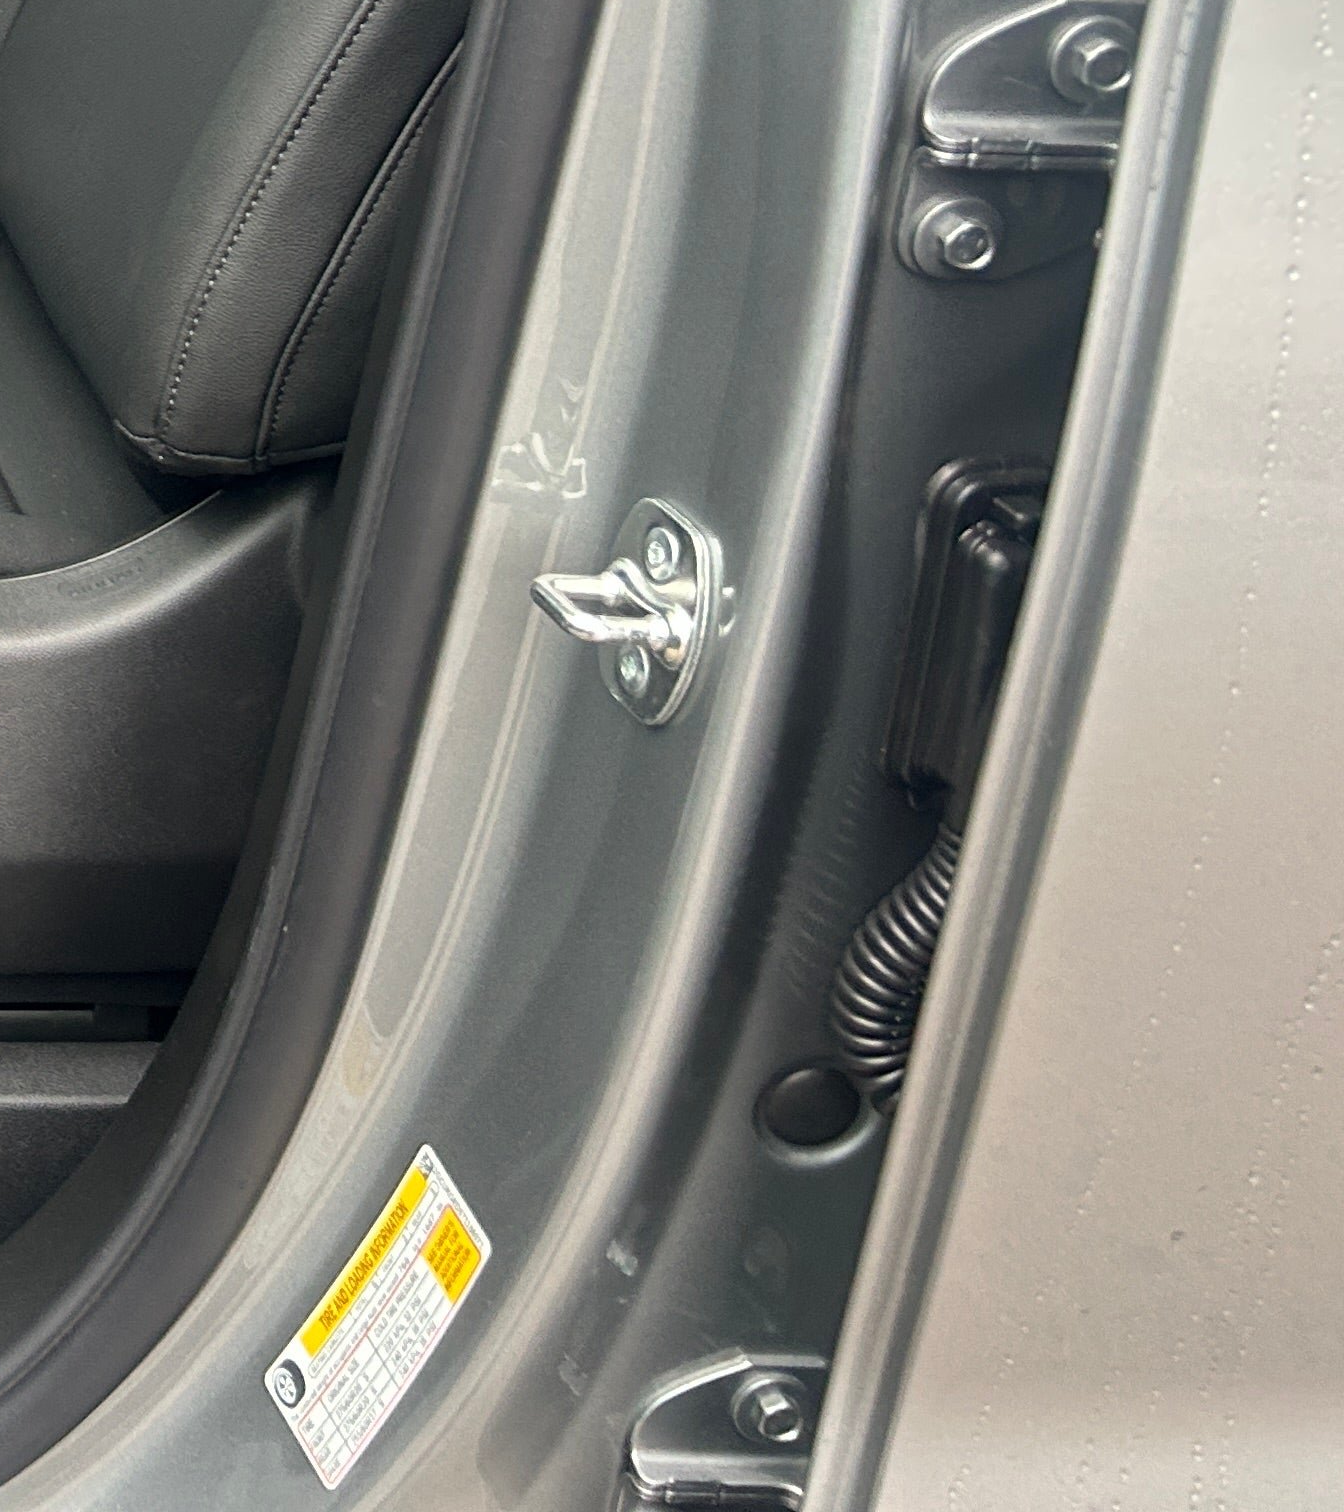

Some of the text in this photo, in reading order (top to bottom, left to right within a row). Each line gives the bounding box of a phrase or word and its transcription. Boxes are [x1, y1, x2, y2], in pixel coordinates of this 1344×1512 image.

[318, 1197, 409, 1332] TIRE AND LOADING INFORMATION
